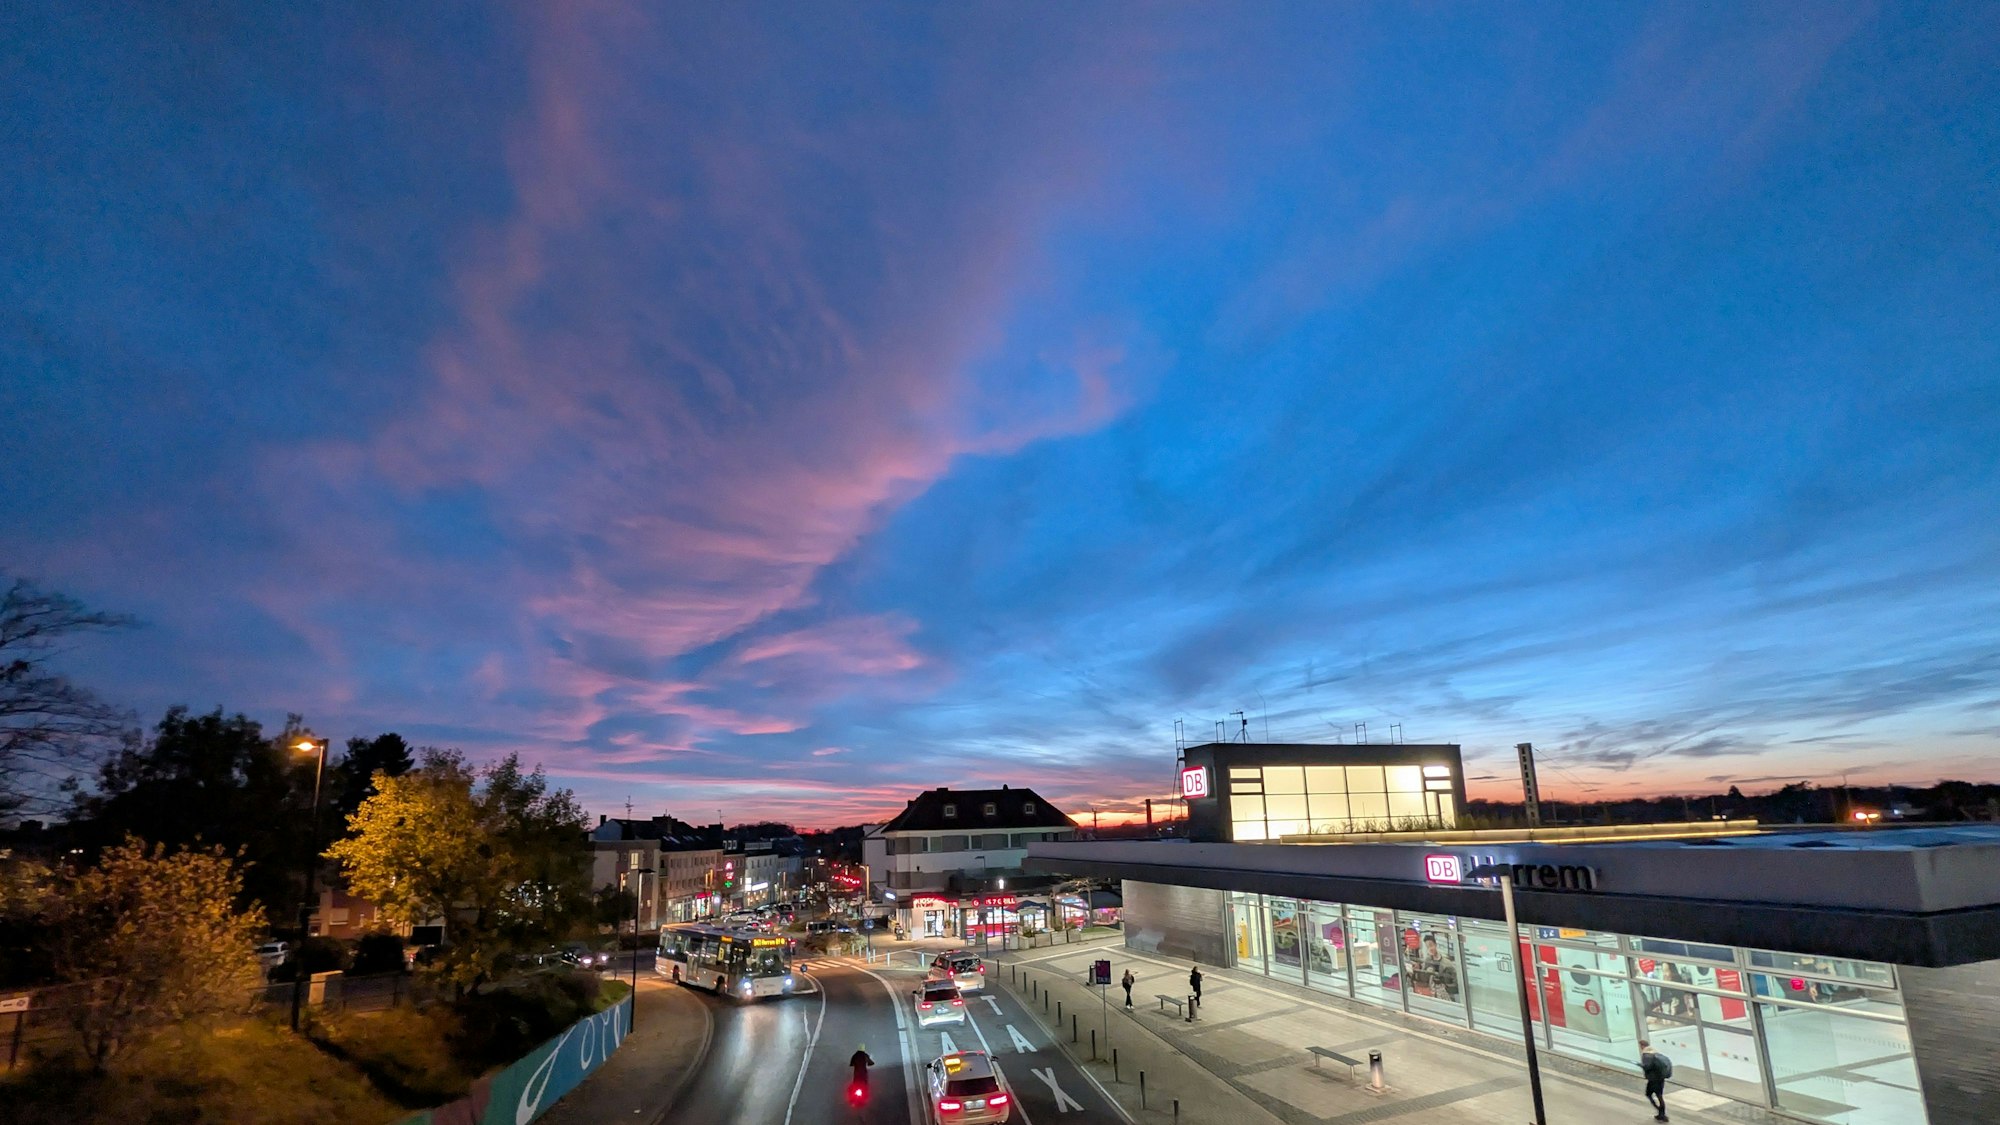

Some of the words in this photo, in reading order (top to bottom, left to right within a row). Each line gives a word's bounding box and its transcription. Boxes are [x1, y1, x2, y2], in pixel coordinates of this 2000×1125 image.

[1186, 773, 1204, 793] DB
[1430, 859, 1454, 877] DB
[1470, 855, 1597, 890] Hrrem
